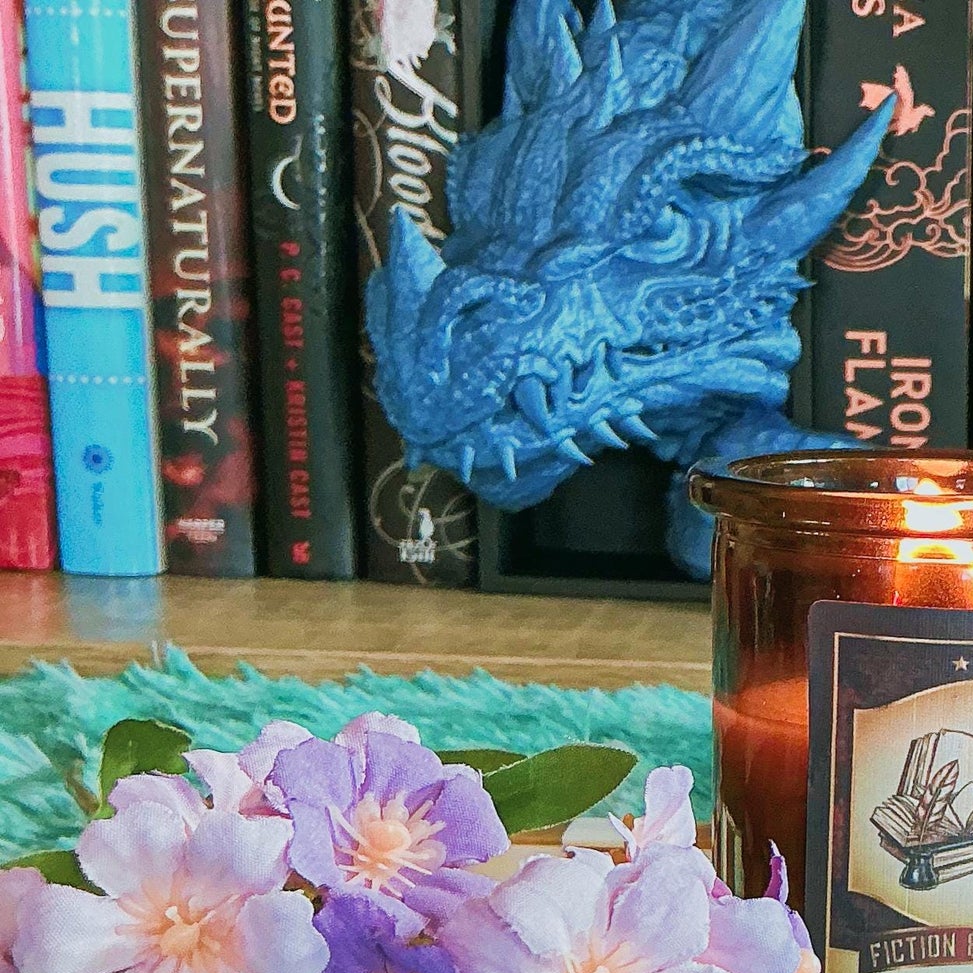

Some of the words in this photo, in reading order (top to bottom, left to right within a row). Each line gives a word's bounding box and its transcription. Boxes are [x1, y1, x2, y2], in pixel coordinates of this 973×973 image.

[265, 0, 297, 125] UNTED
[29, 91, 143, 310] HUSH
[160, 0, 219, 446] UPERNATURALLY
[843, 330, 888, 440] FLA
[870, 931, 957, 968] FICTION
